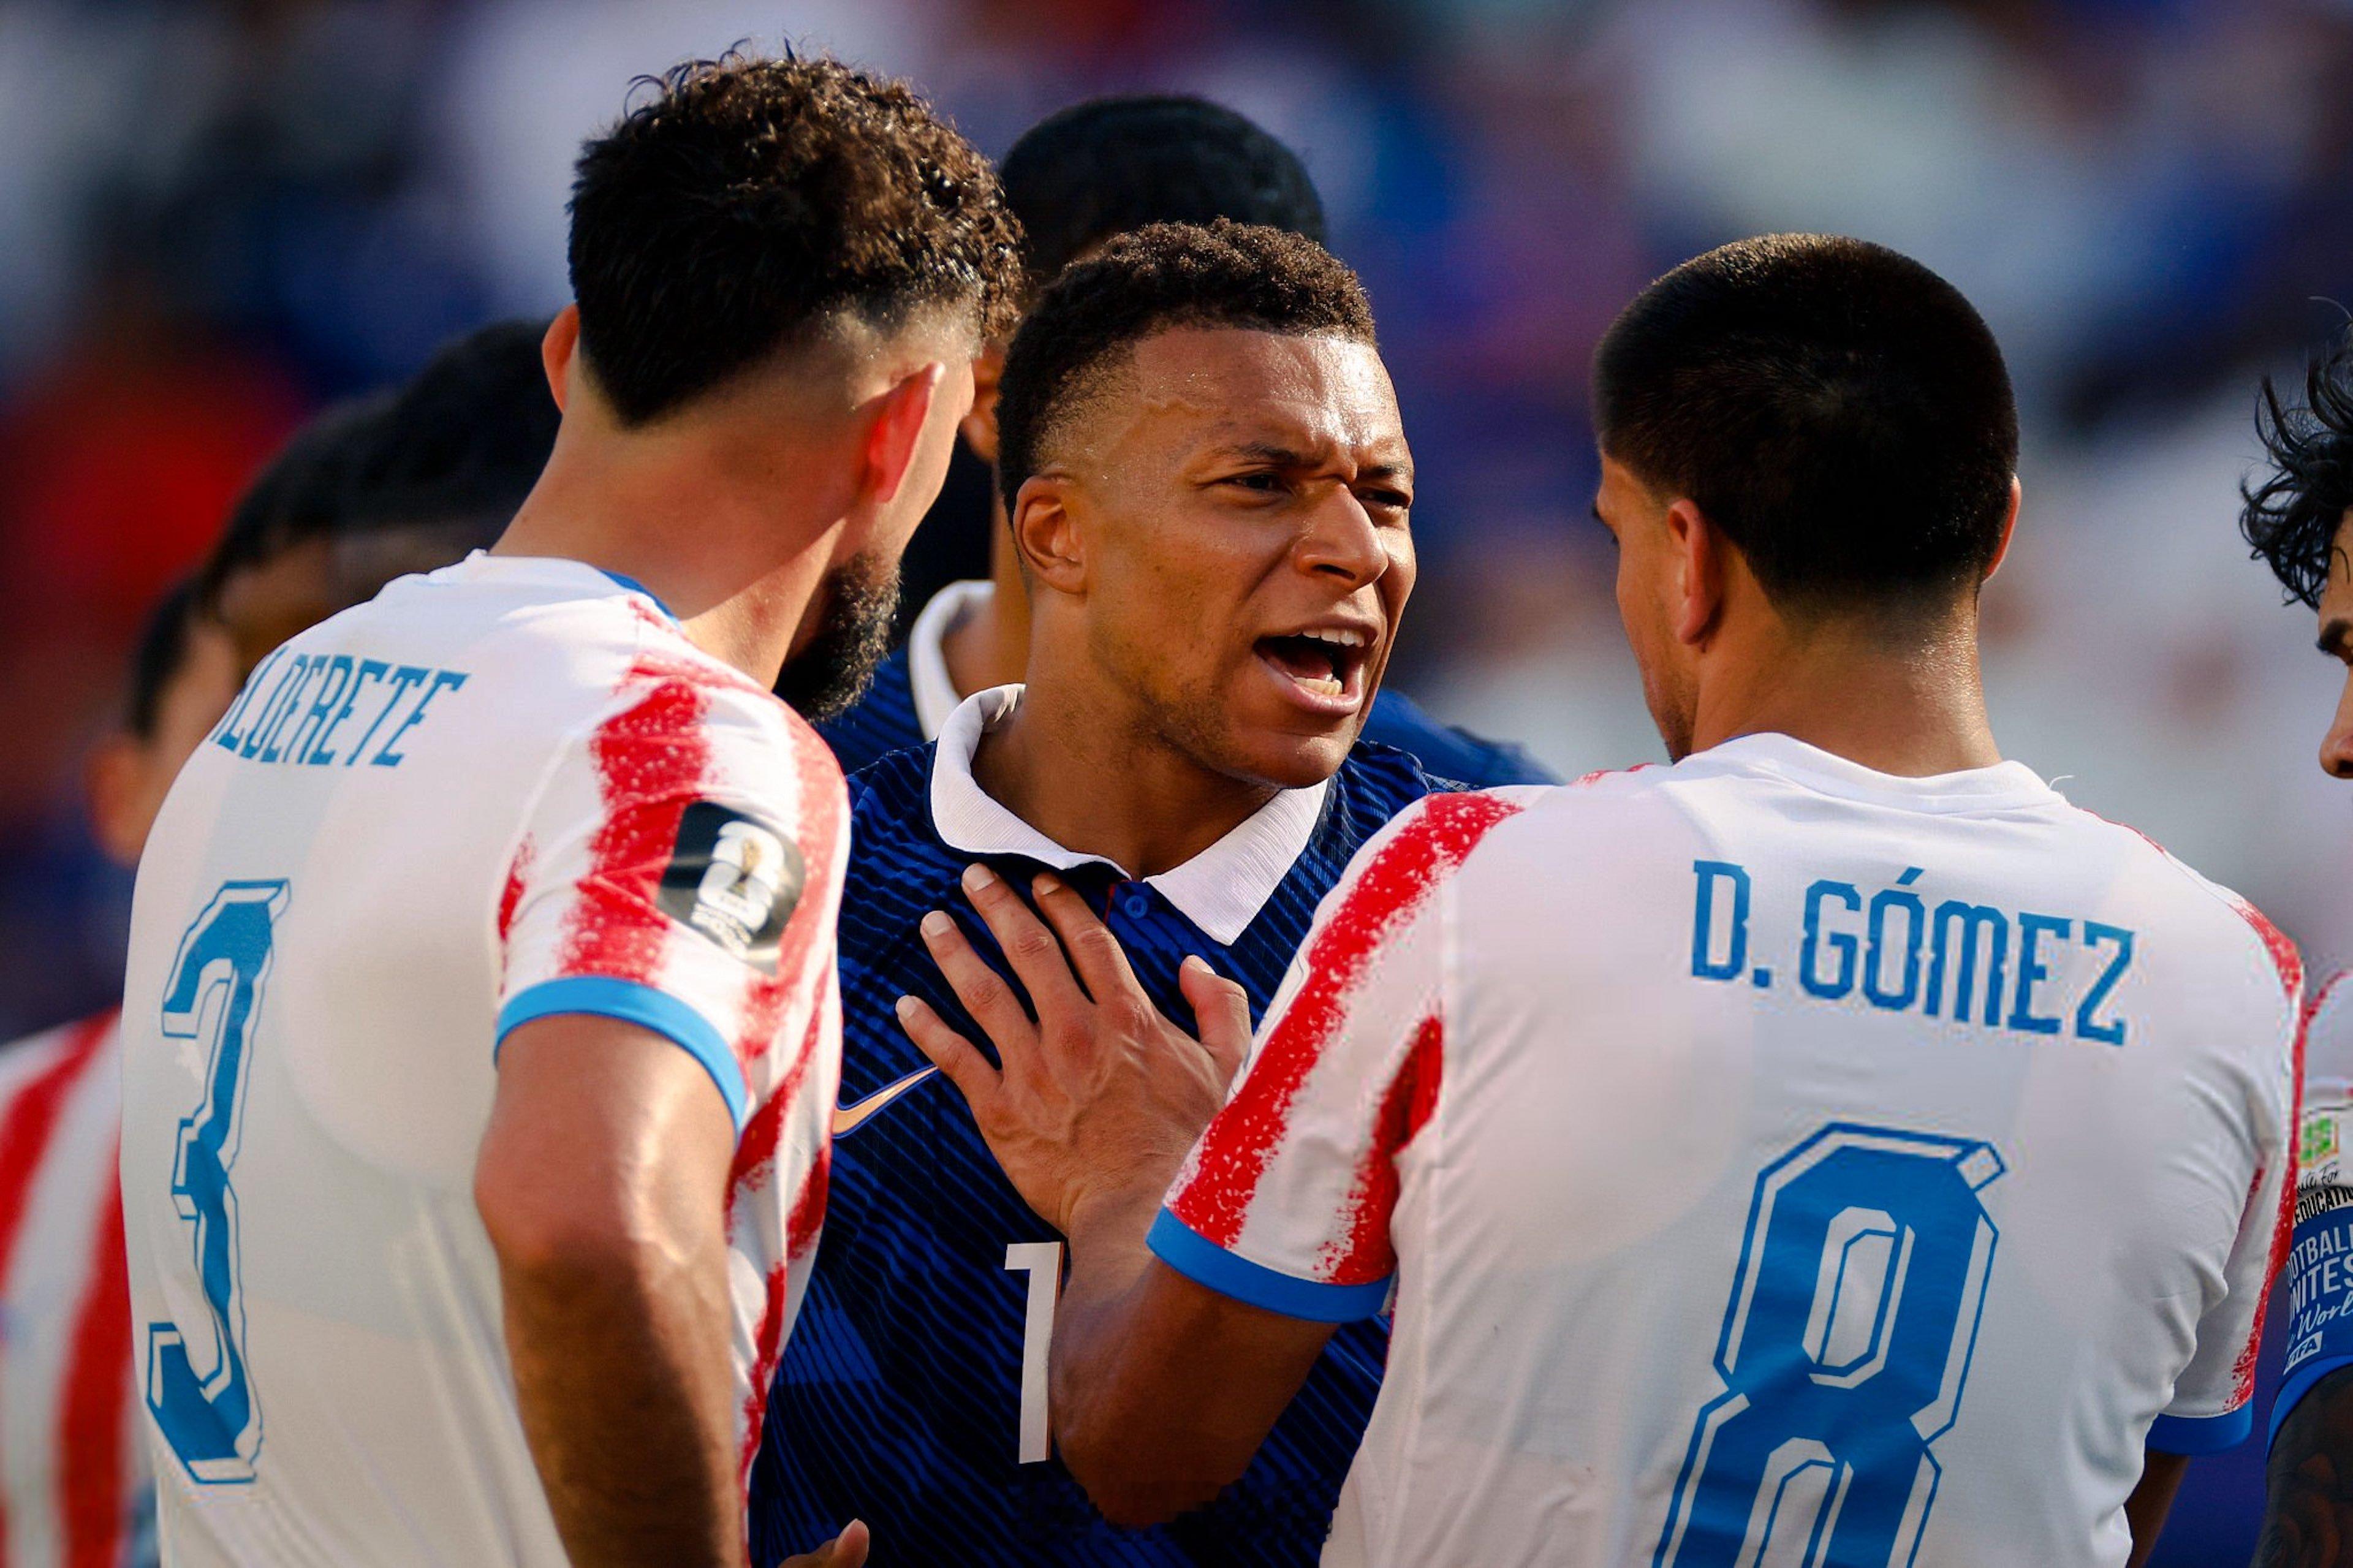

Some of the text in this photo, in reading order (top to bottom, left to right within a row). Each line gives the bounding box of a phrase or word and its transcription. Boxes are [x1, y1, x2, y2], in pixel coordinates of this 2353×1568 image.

[1692, 859, 2136, 1047] D. GÓMEZ
[146, 878, 292, 1484] 3
[1651, 1121, 2009, 1568] 8
